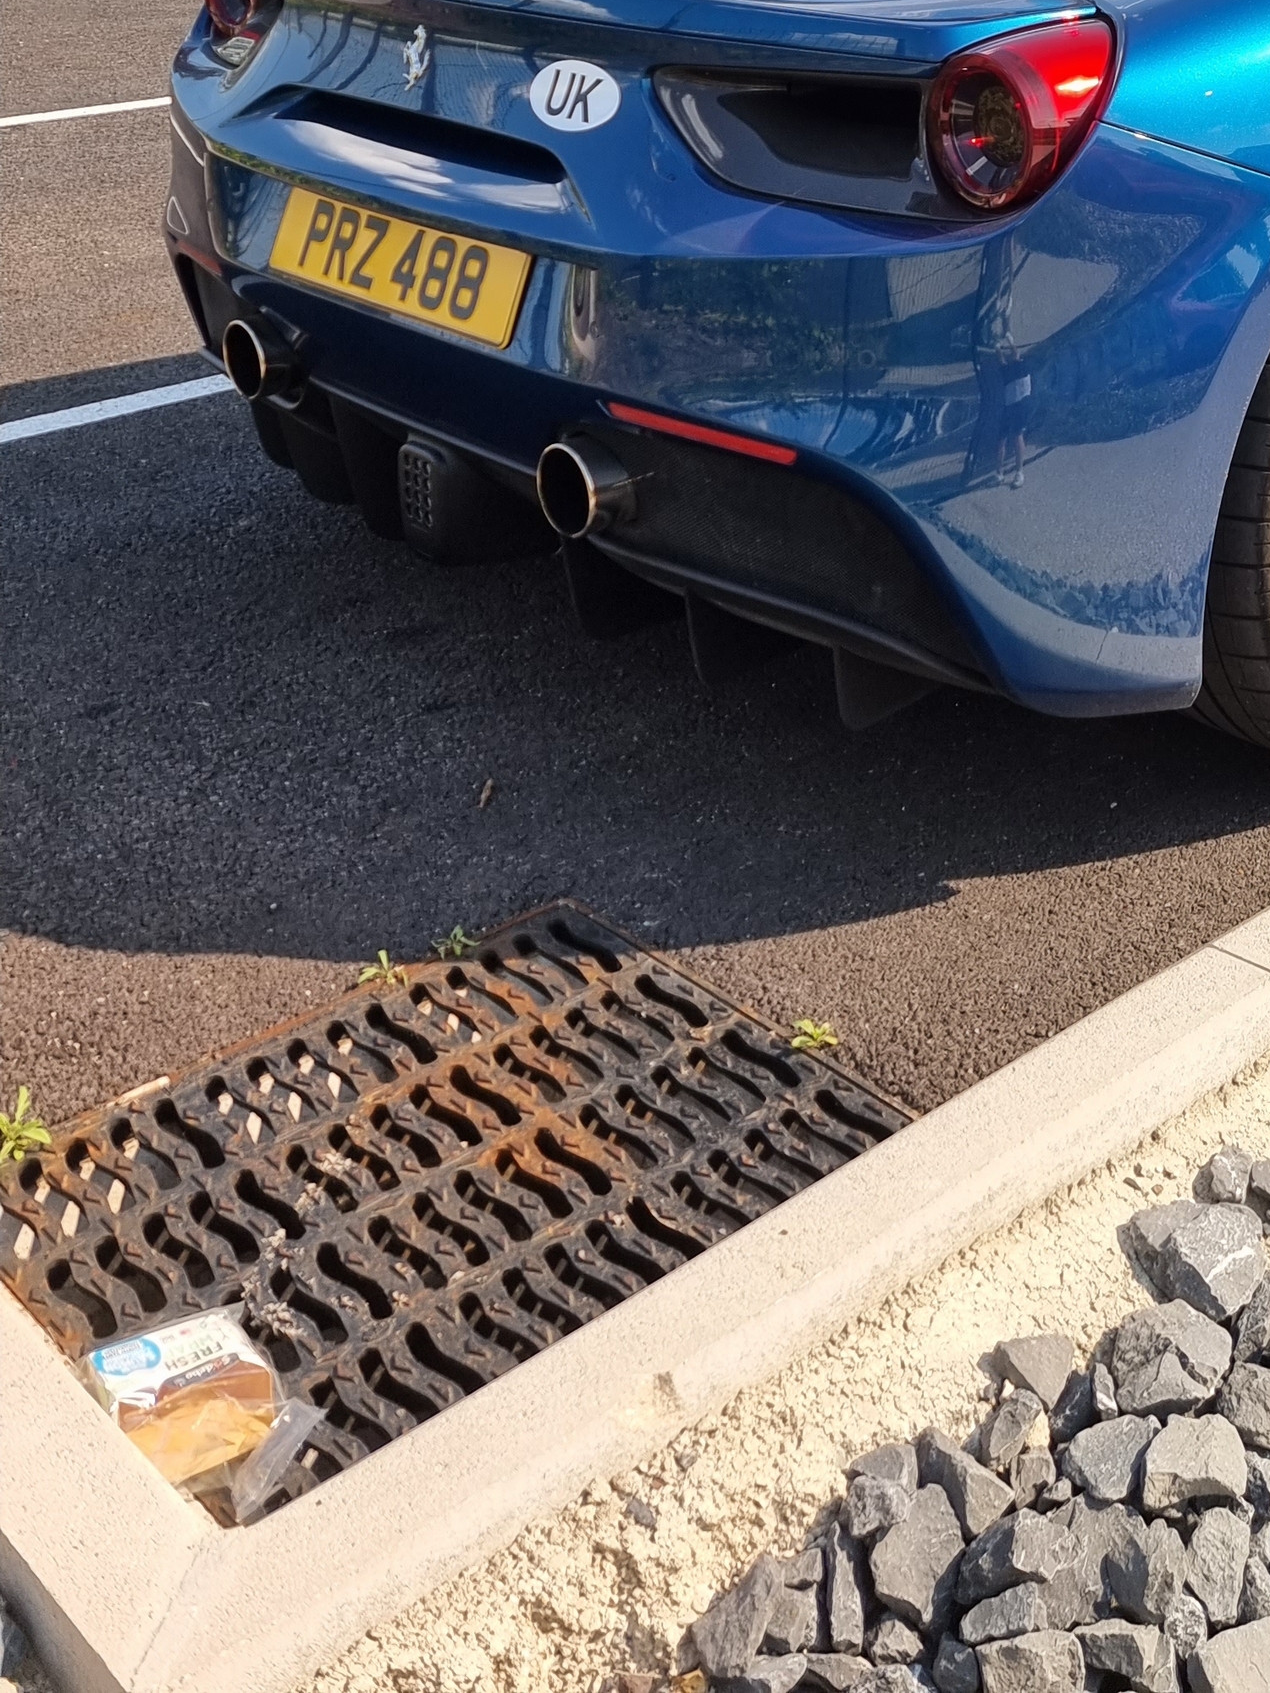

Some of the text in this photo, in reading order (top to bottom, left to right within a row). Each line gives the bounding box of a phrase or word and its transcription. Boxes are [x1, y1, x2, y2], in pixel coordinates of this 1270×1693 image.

[544, 68, 604, 124] UK
[298, 198, 489, 320] PRZ 488
[165, 1341, 224, 1371] FRESH
